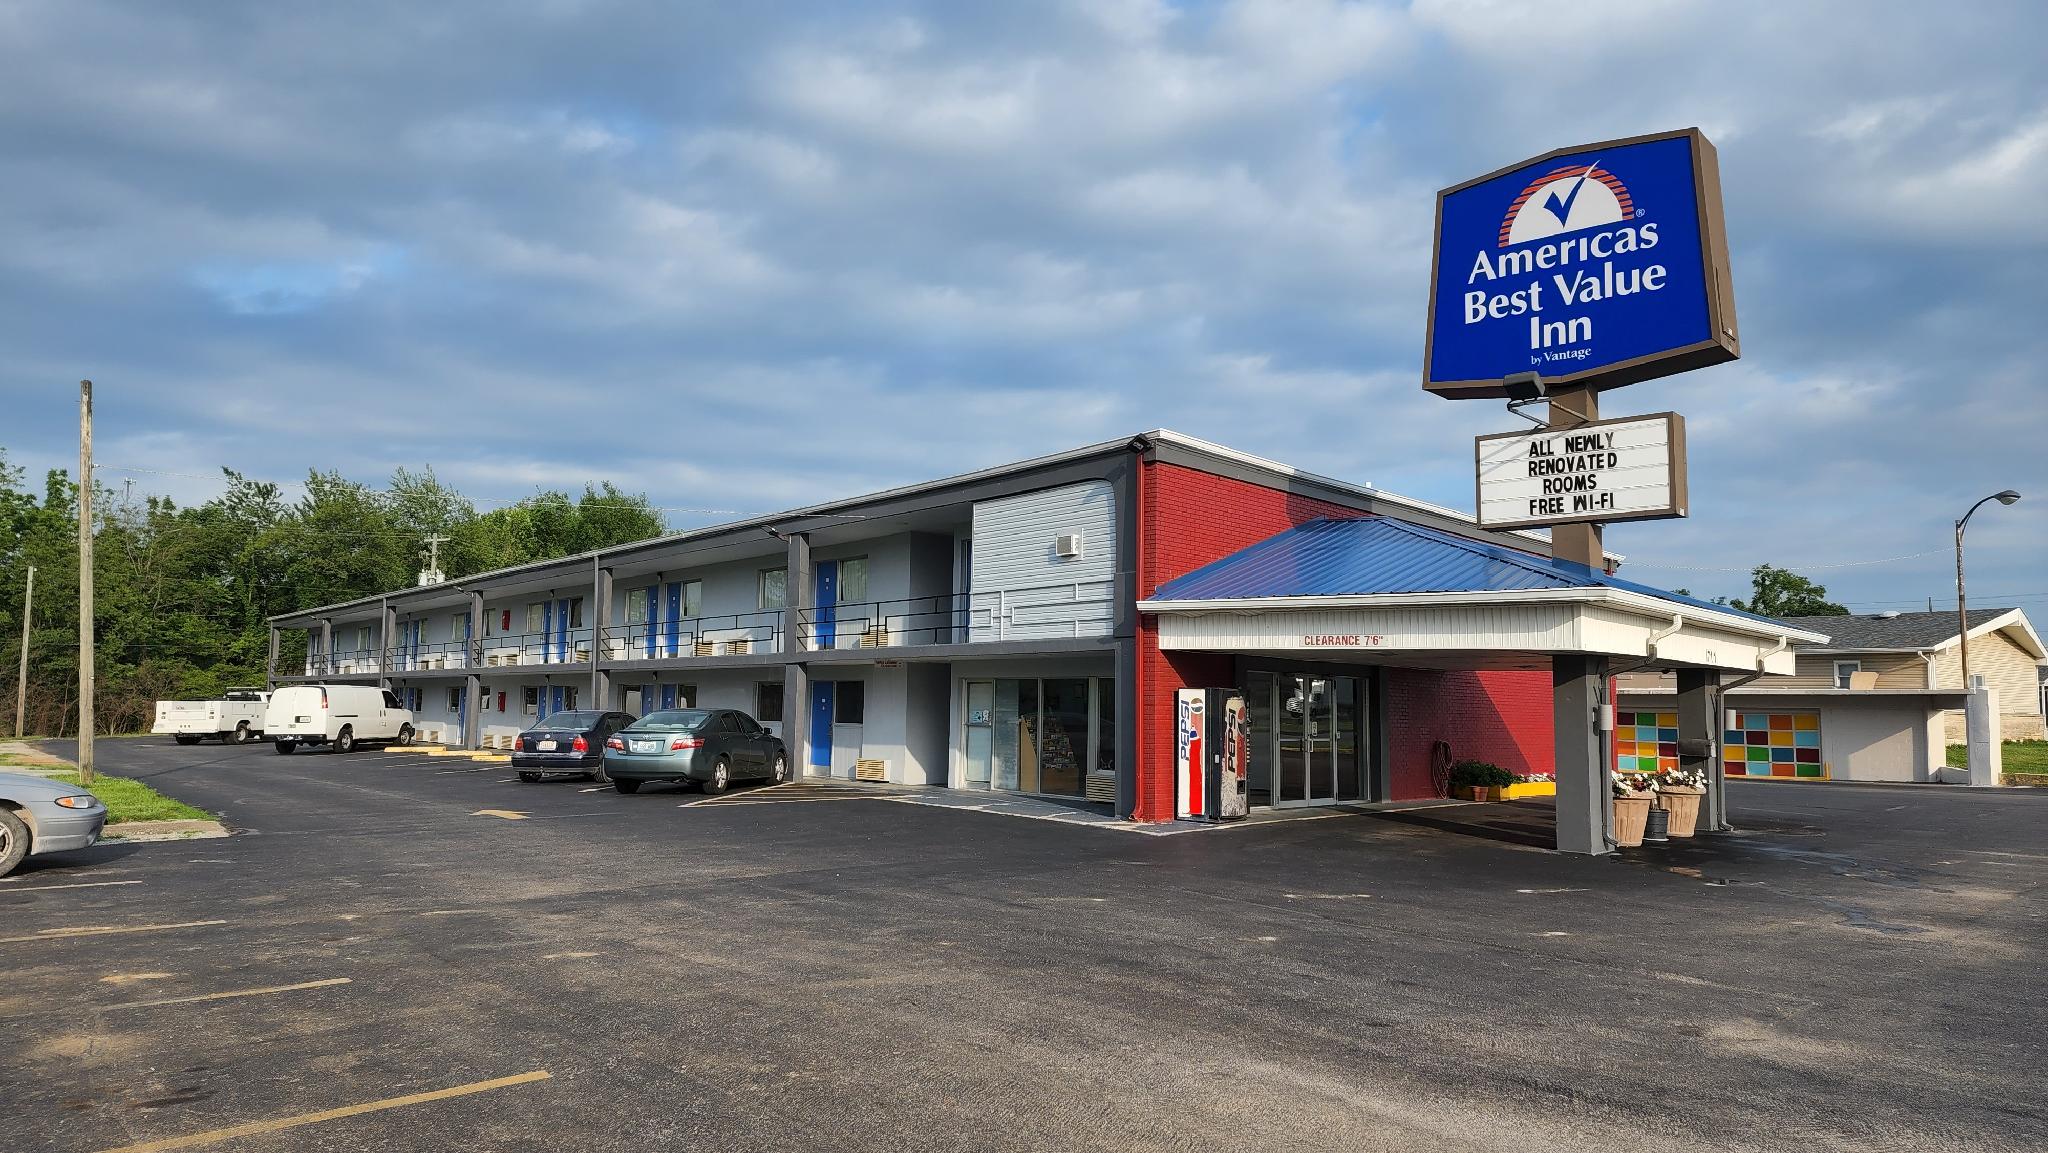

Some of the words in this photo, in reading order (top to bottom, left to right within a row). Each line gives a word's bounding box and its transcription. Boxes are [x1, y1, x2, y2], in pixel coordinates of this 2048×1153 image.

[1467, 222, 1659, 284] Americas
[1465, 280, 1543, 324] Best
[1553, 261, 1667, 306] Value
[1531, 316, 1592, 350] Inn
[1531, 355, 1542, 366] by
[1543, 348, 1592, 362] Vantage
[1529, 439, 1554, 457] ALL
[1565, 432, 1614, 453] NEWLY
[1528, 452, 1617, 477] RENOVATED
[1543, 474, 1597, 494] ROOMS
[1529, 497, 1564, 515] FREE
[1573, 492, 1615, 511] WI-FI
[1304, 635, 1360, 646] CLEARANCE
[1180, 700, 1190, 761] PEPSI
[1228, 708, 1236, 773] PEPSI
